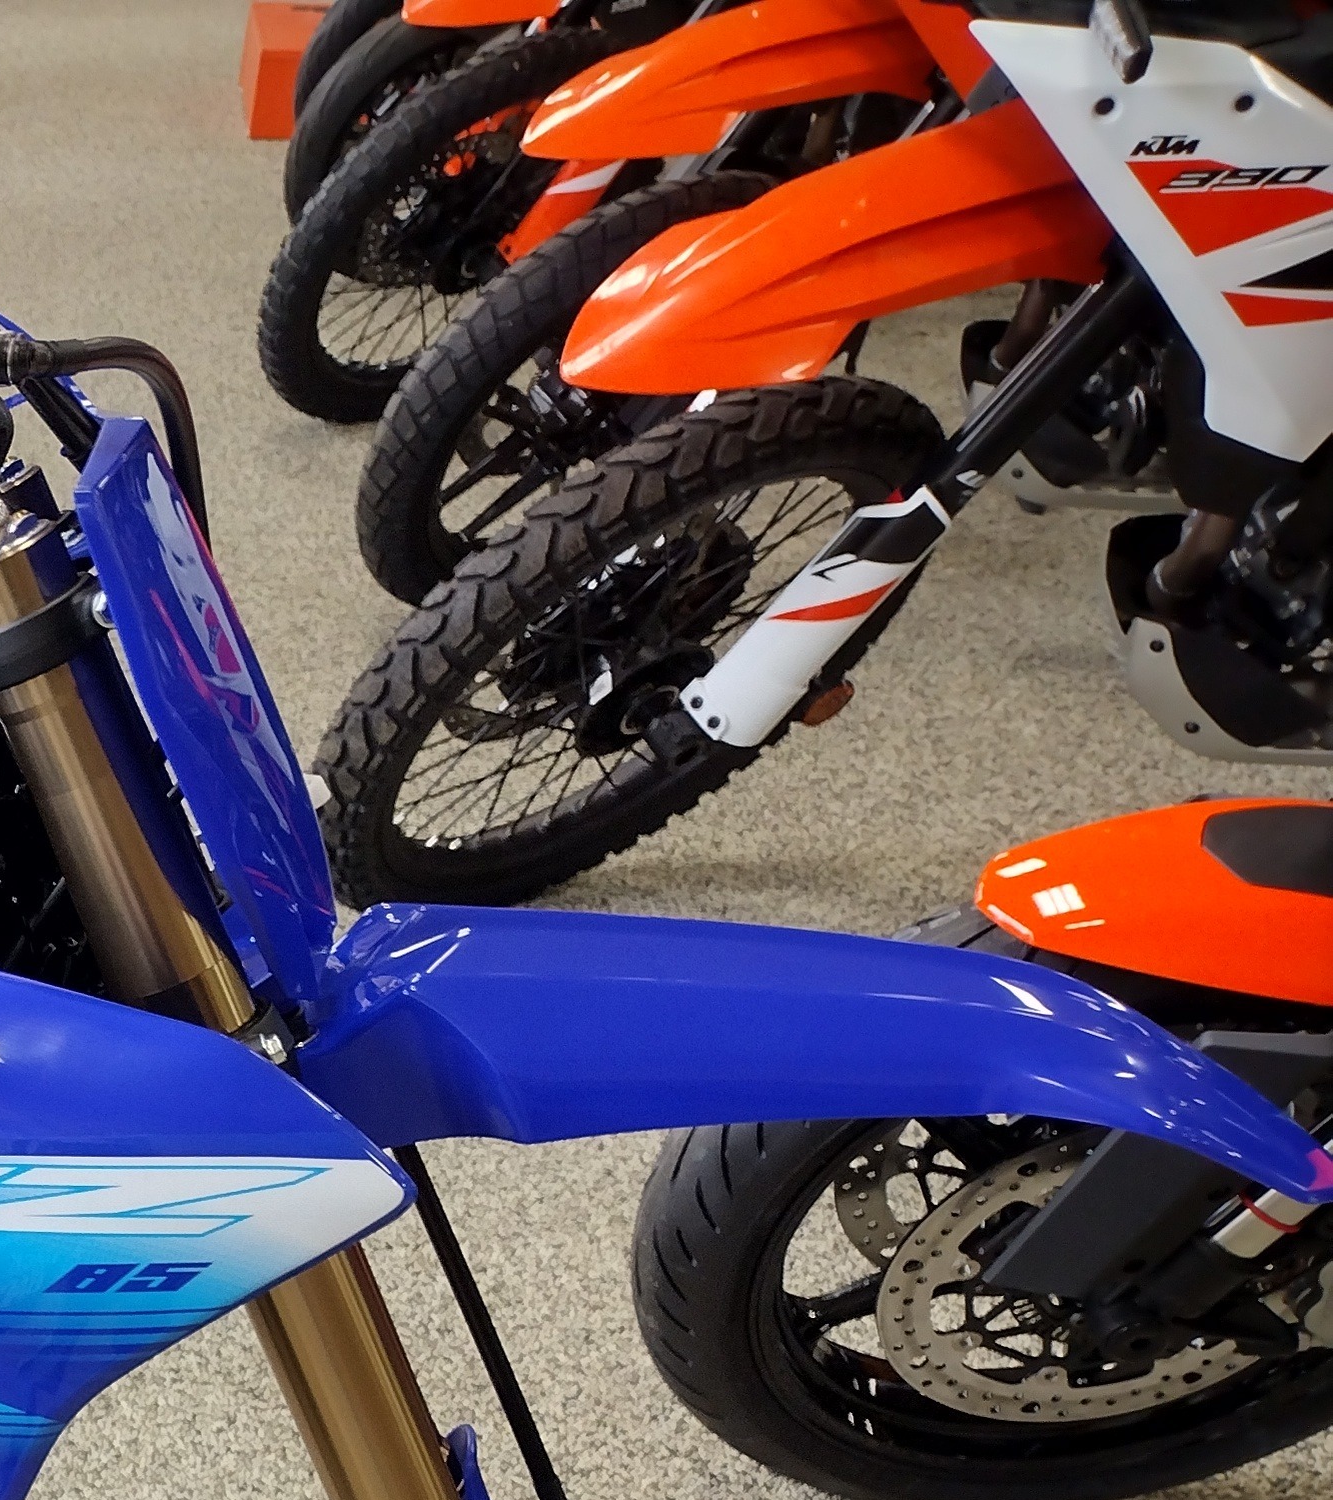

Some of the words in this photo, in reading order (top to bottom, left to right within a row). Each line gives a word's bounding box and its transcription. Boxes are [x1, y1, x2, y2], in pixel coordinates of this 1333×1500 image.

[1130, 134, 1201, 157] KTM
[1159, 164, 1331, 193] 390
[42, 1261, 213, 1294] 85
